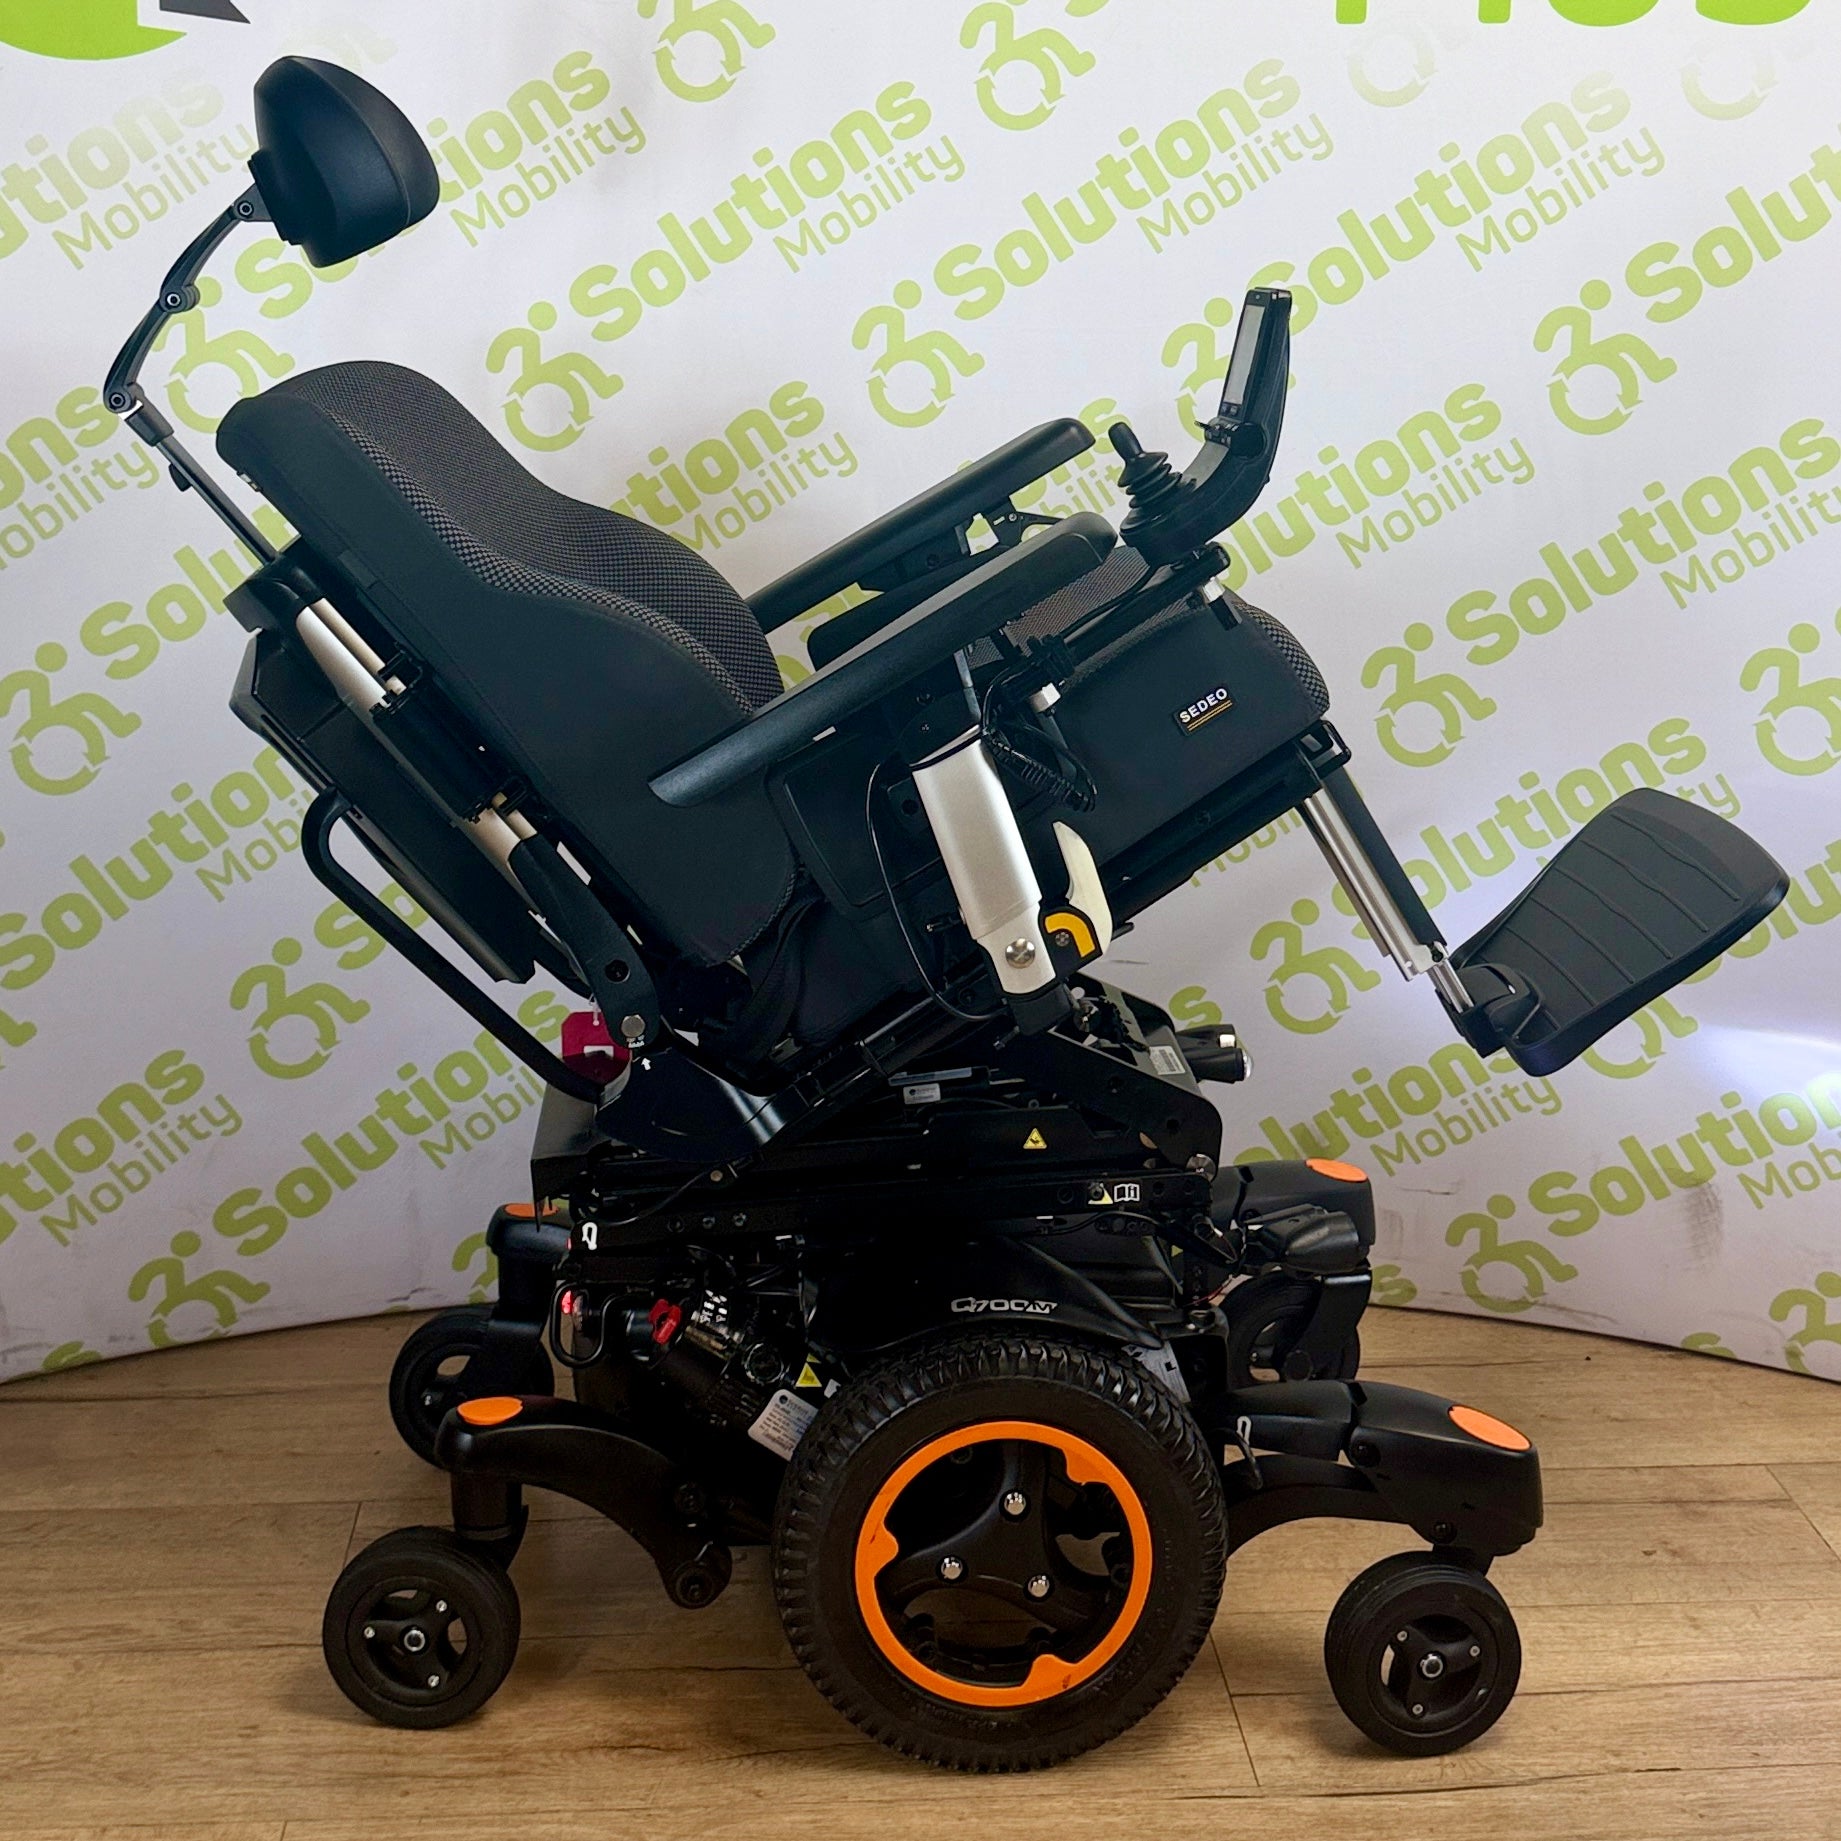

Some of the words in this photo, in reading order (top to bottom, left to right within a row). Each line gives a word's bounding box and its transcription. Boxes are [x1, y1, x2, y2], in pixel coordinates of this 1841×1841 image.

[449, 106, 646, 248] Mobility
[569, 81, 932, 342] Solutions
[773, 134, 966, 274] Mobility
[933, 58, 1301, 321] Solutions
[1136, 112, 1334, 255] Mobility
[1455, 126, 1665, 273] Mobility
[0, 440, 160, 570] obility
[609, 380, 825, 527] tions
[670, 431, 858, 550] Mobility
[1335, 437, 1536, 570] Mobility
[1446, 418, 1841, 665] Solutions
[1659, 485, 1841, 611] Mobilit
[1179, 688, 1228, 724] SEDEO
[0, 1049, 205, 1246] tions
[39, 1093, 243, 1248] Mobility
[1369, 1076, 1563, 1178] Mobility
